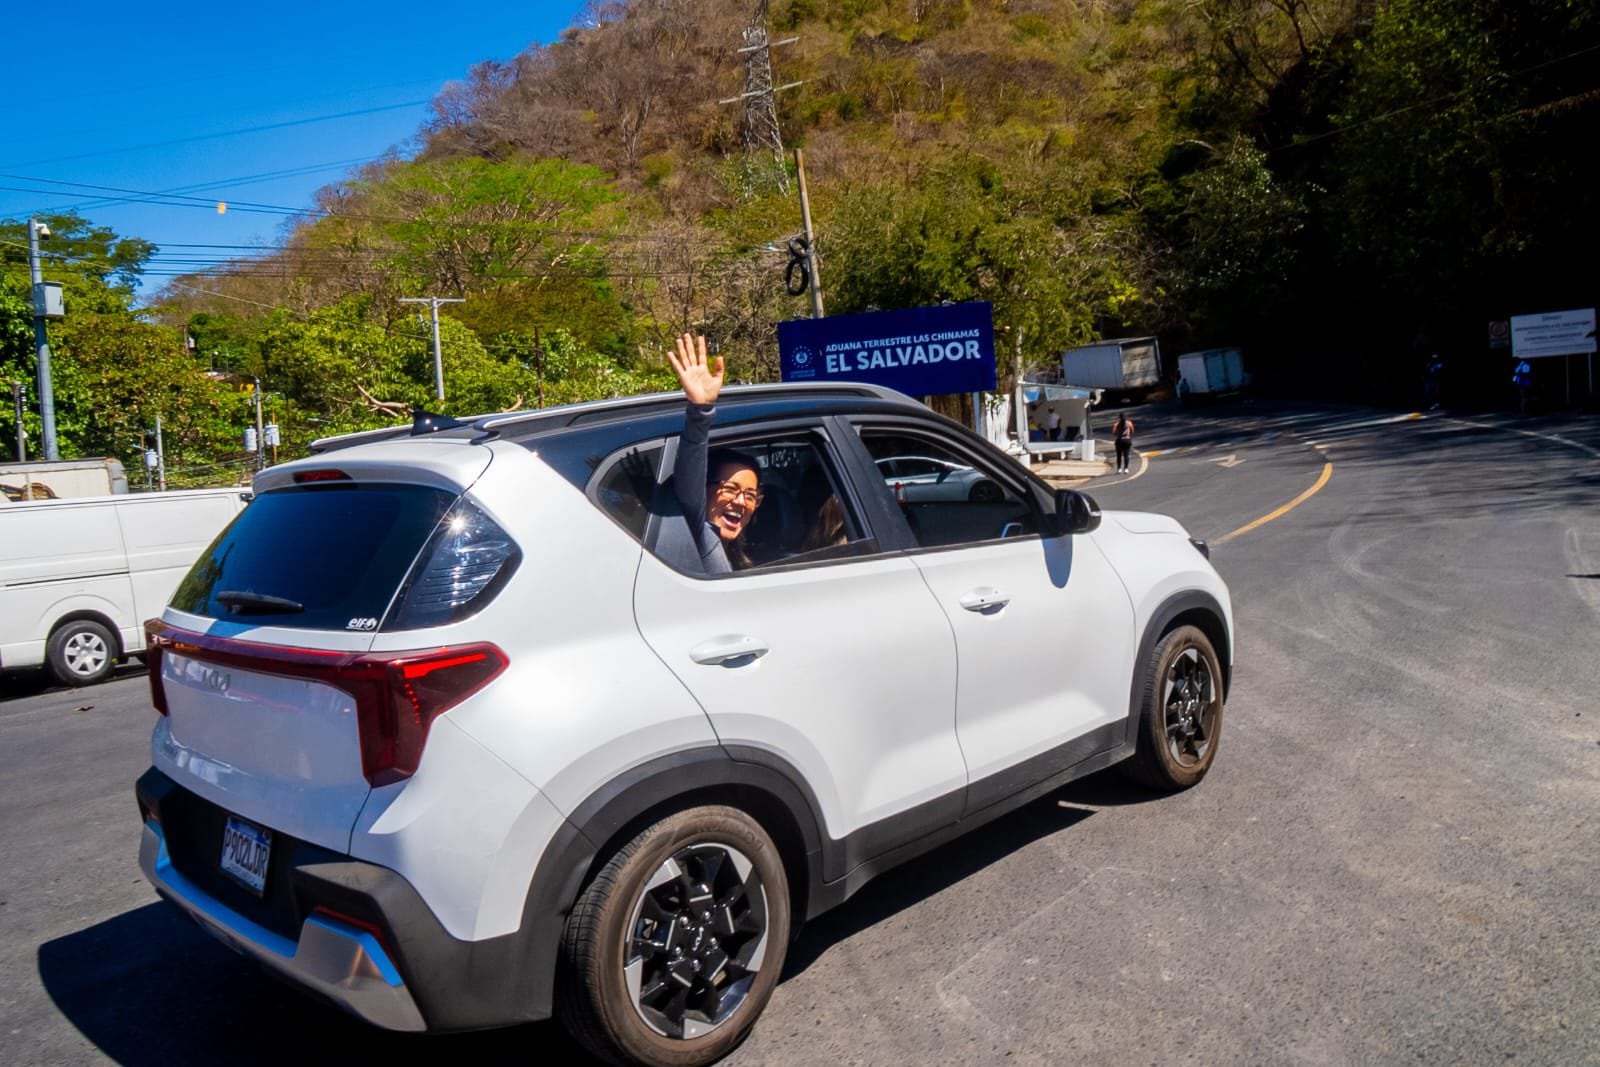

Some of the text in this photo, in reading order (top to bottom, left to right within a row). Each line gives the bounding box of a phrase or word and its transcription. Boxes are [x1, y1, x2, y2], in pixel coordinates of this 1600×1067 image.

[827, 328, 980, 352] ADUANA TERRESTRE LAS CHINAMAS
[826, 340, 981, 373] EL SALVADOR
